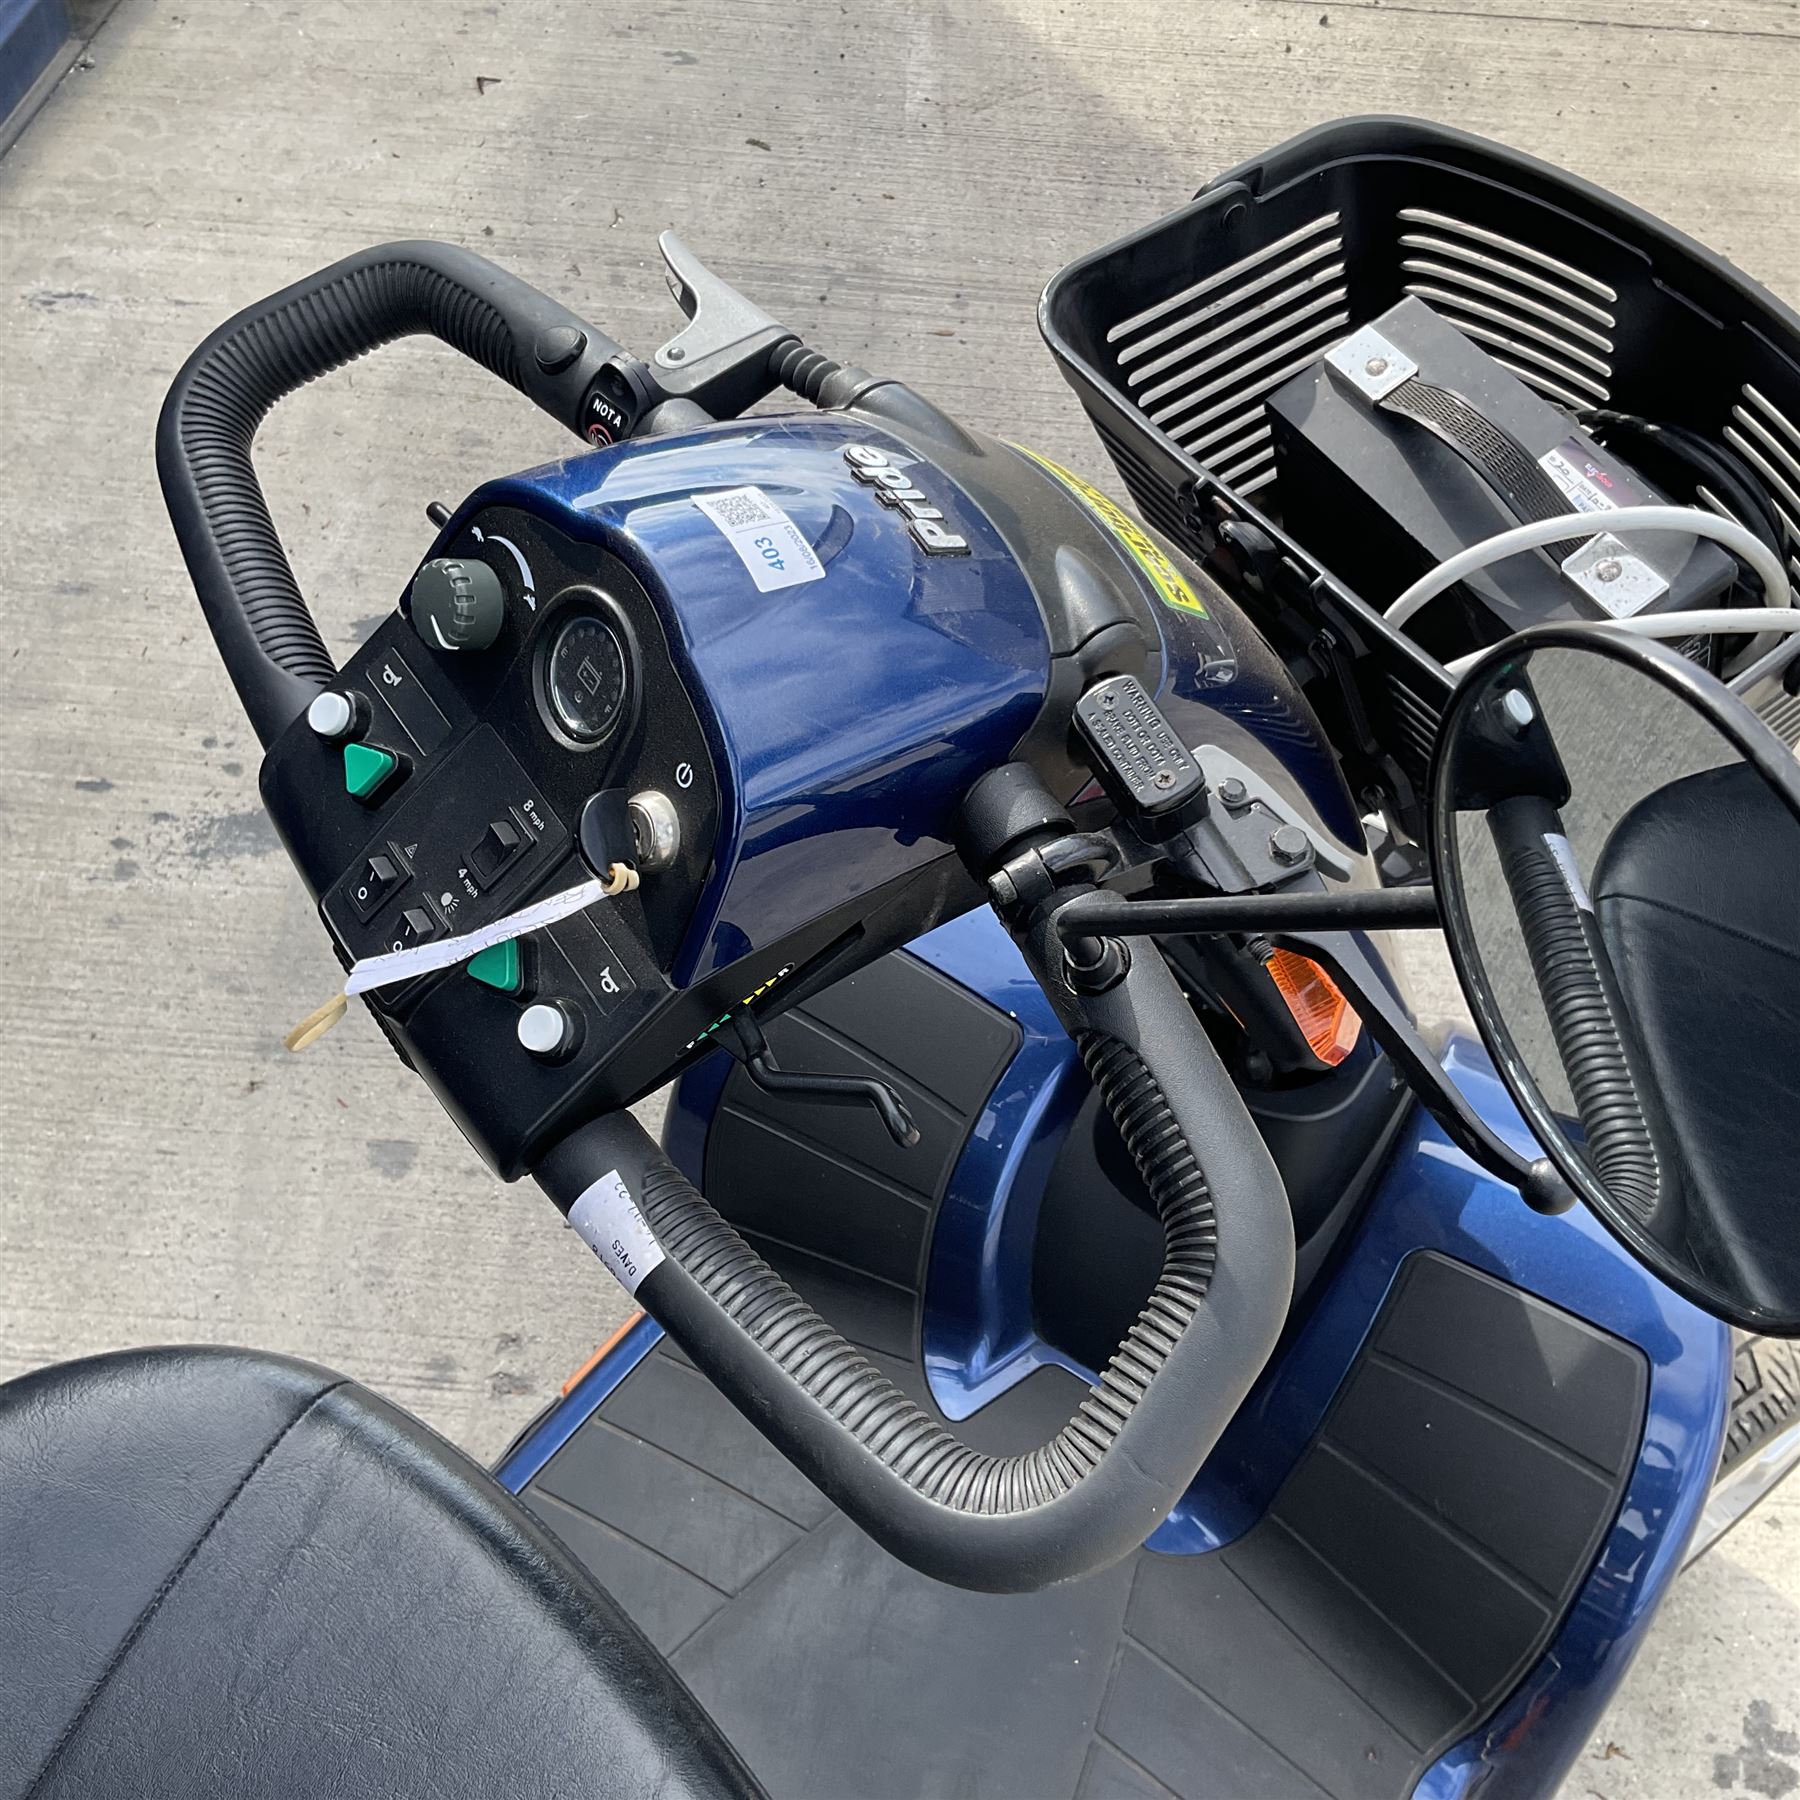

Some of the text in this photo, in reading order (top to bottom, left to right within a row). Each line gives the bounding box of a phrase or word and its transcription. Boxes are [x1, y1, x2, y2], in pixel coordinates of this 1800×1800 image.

[593, 398, 622, 428] NOT A
[846, 445, 969, 552] Pride
[754, 537, 785, 571] 403
[1122, 680, 1162, 731] WARNING
[1092, 719, 1116, 750] SEALED
[1103, 709, 1158, 781] BRAKE FLUID FROM
[1138, 729, 1152, 746] OR
[522, 799, 546, 832] 8 mph
[457, 868, 479, 899] 4 mph
[611, 1239, 638, 1277] DAVES
